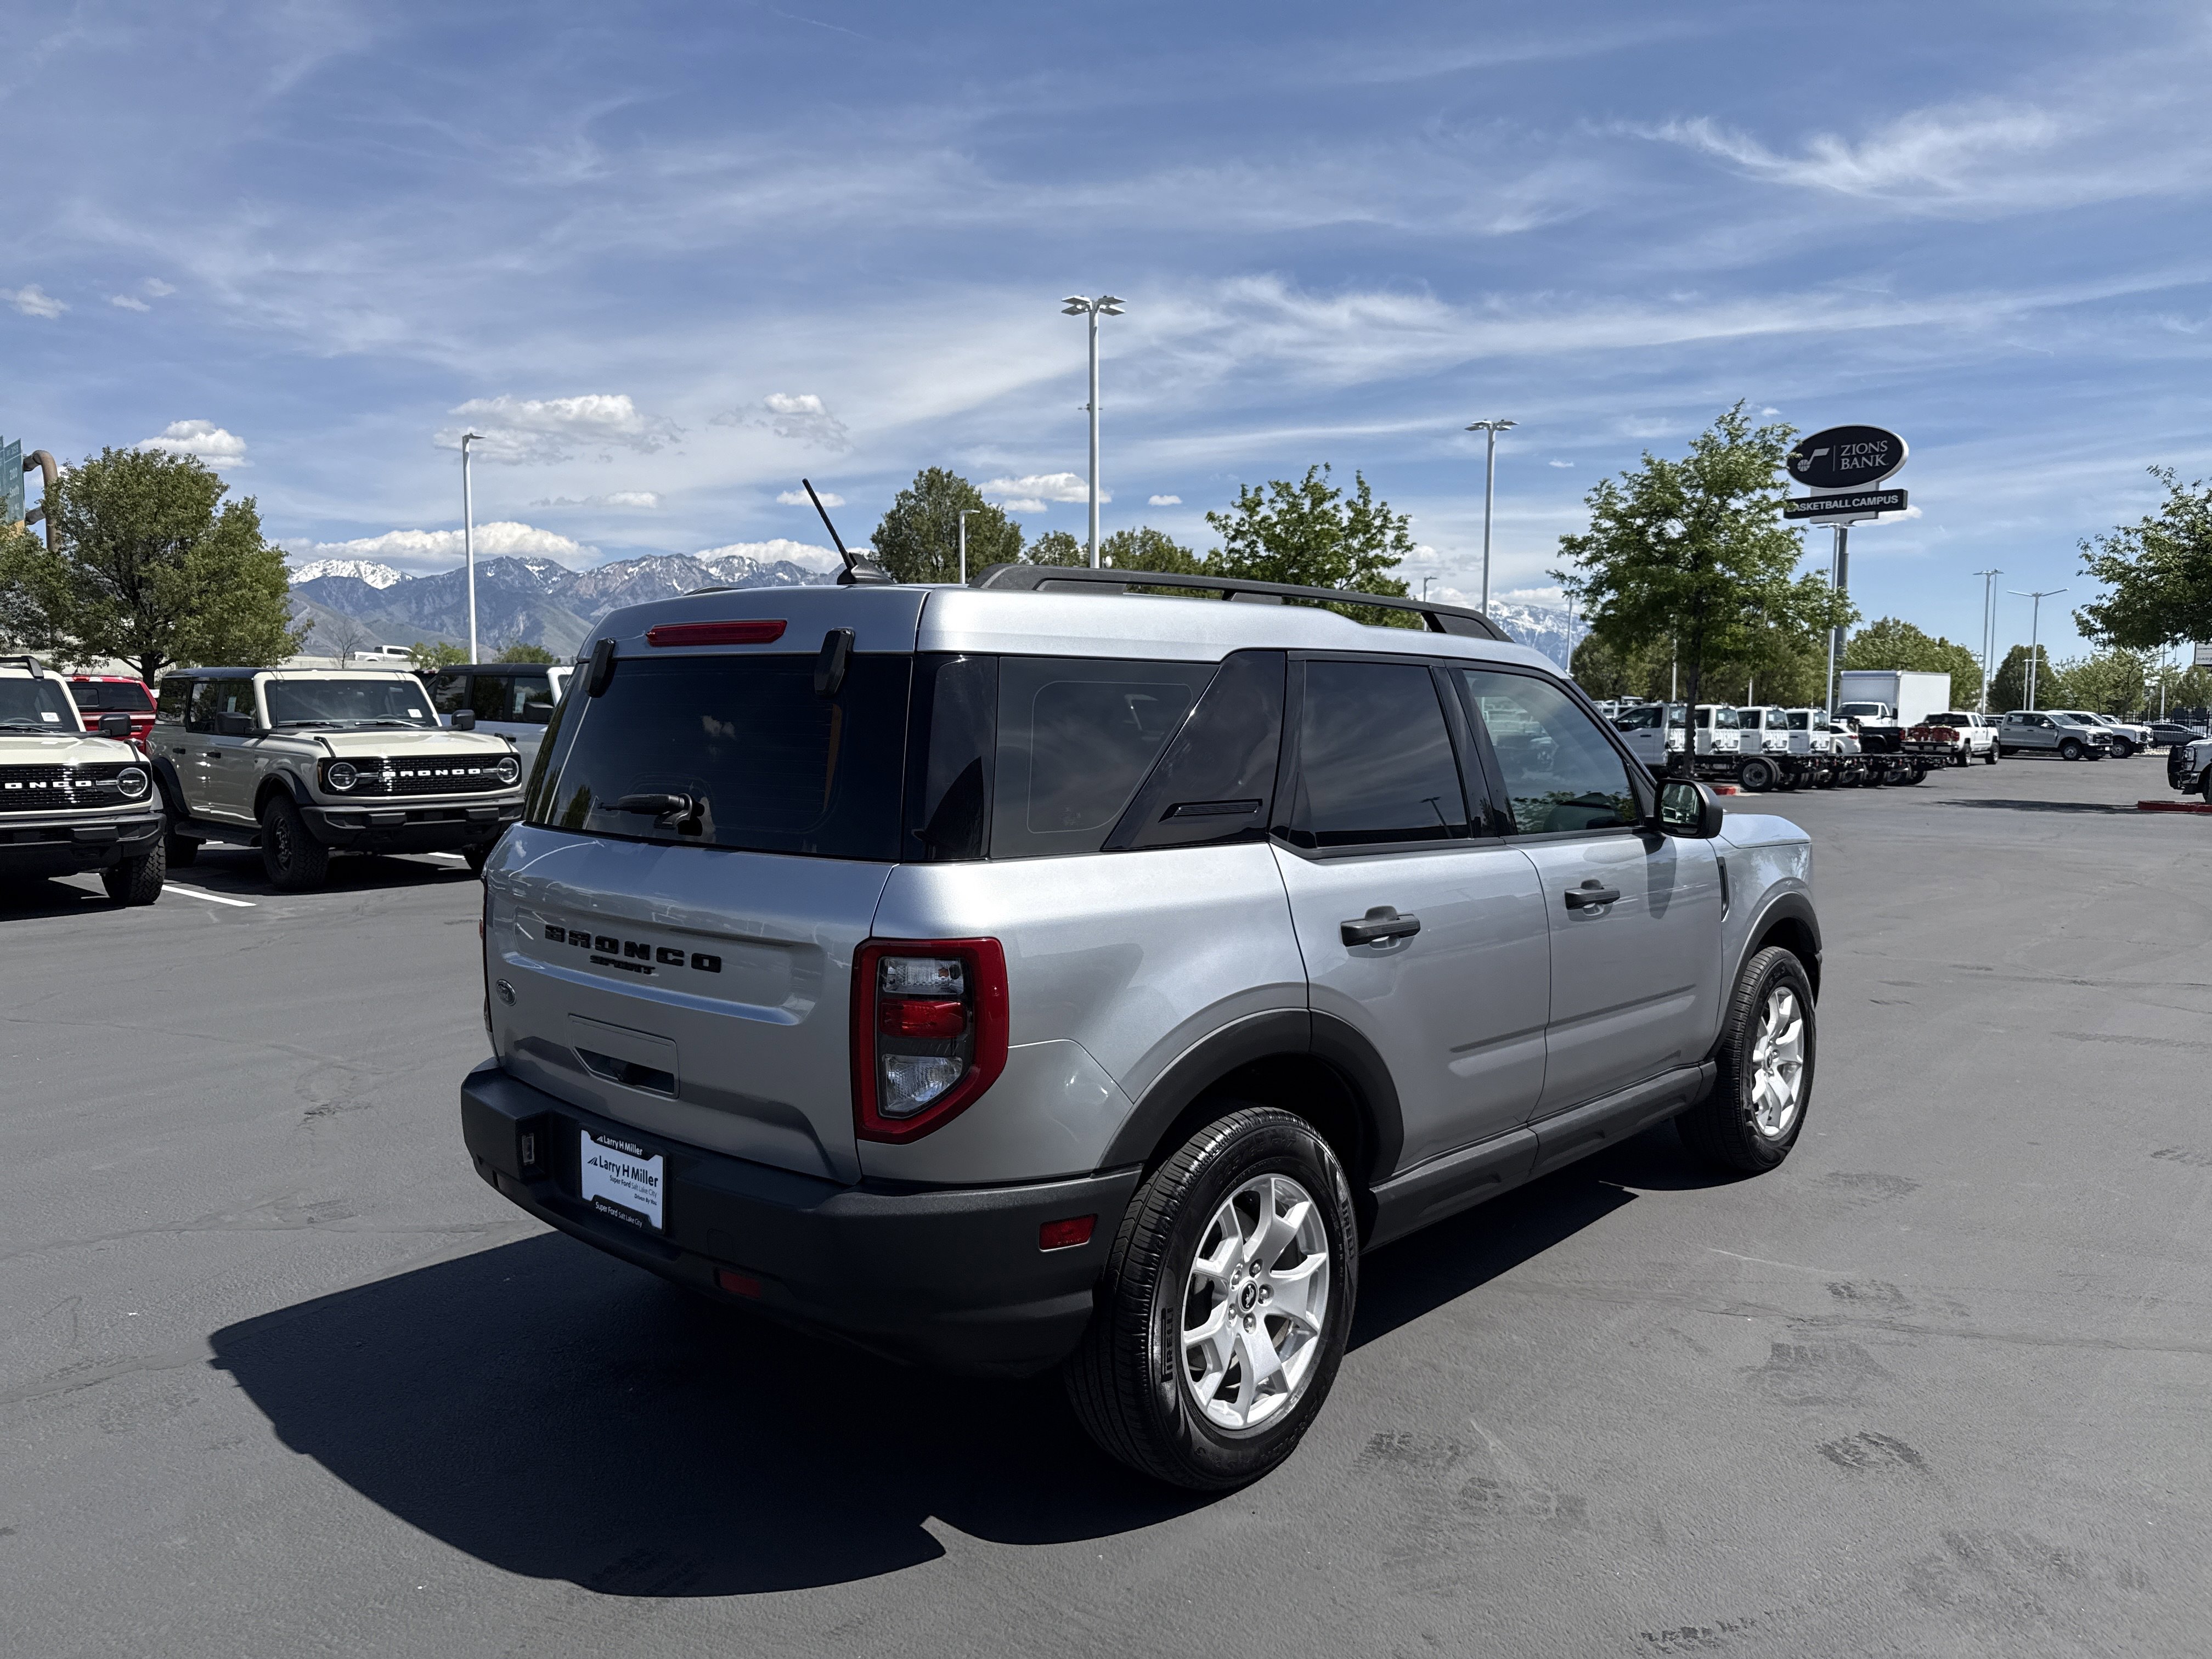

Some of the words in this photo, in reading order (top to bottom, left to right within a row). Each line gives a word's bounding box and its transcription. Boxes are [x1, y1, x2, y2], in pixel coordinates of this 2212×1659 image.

[1839, 440, 1888, 456] ZIONS
[1839, 454, 1888, 471] BANK
[1852, 494, 1899, 507] CAMPUS
[382, 768, 481, 777] BRONCO
[545, 924, 722, 973] BRONCO
[590, 955, 656, 974] SPORT
[603, 1135, 619, 1149] Larry
[619, 1140, 624, 1150] H
[624, 1142, 643, 1155] Miller
[599, 1155, 620, 1177] Larry
[622, 1164, 629, 1178] H
[631, 1166, 658, 1187] Miller
[610, 1175, 621, 1184] Super
[621, 1179, 631, 1188] Ford
[639, 1186, 648, 1194] Lake
[648, 1188, 657, 1198] City
[595, 1201, 608, 1212] Super
[608, 1206, 618, 1217] Ford
[625, 1214, 635, 1224] Lake
[1160, 1307, 1173, 1383] PIRELLI
